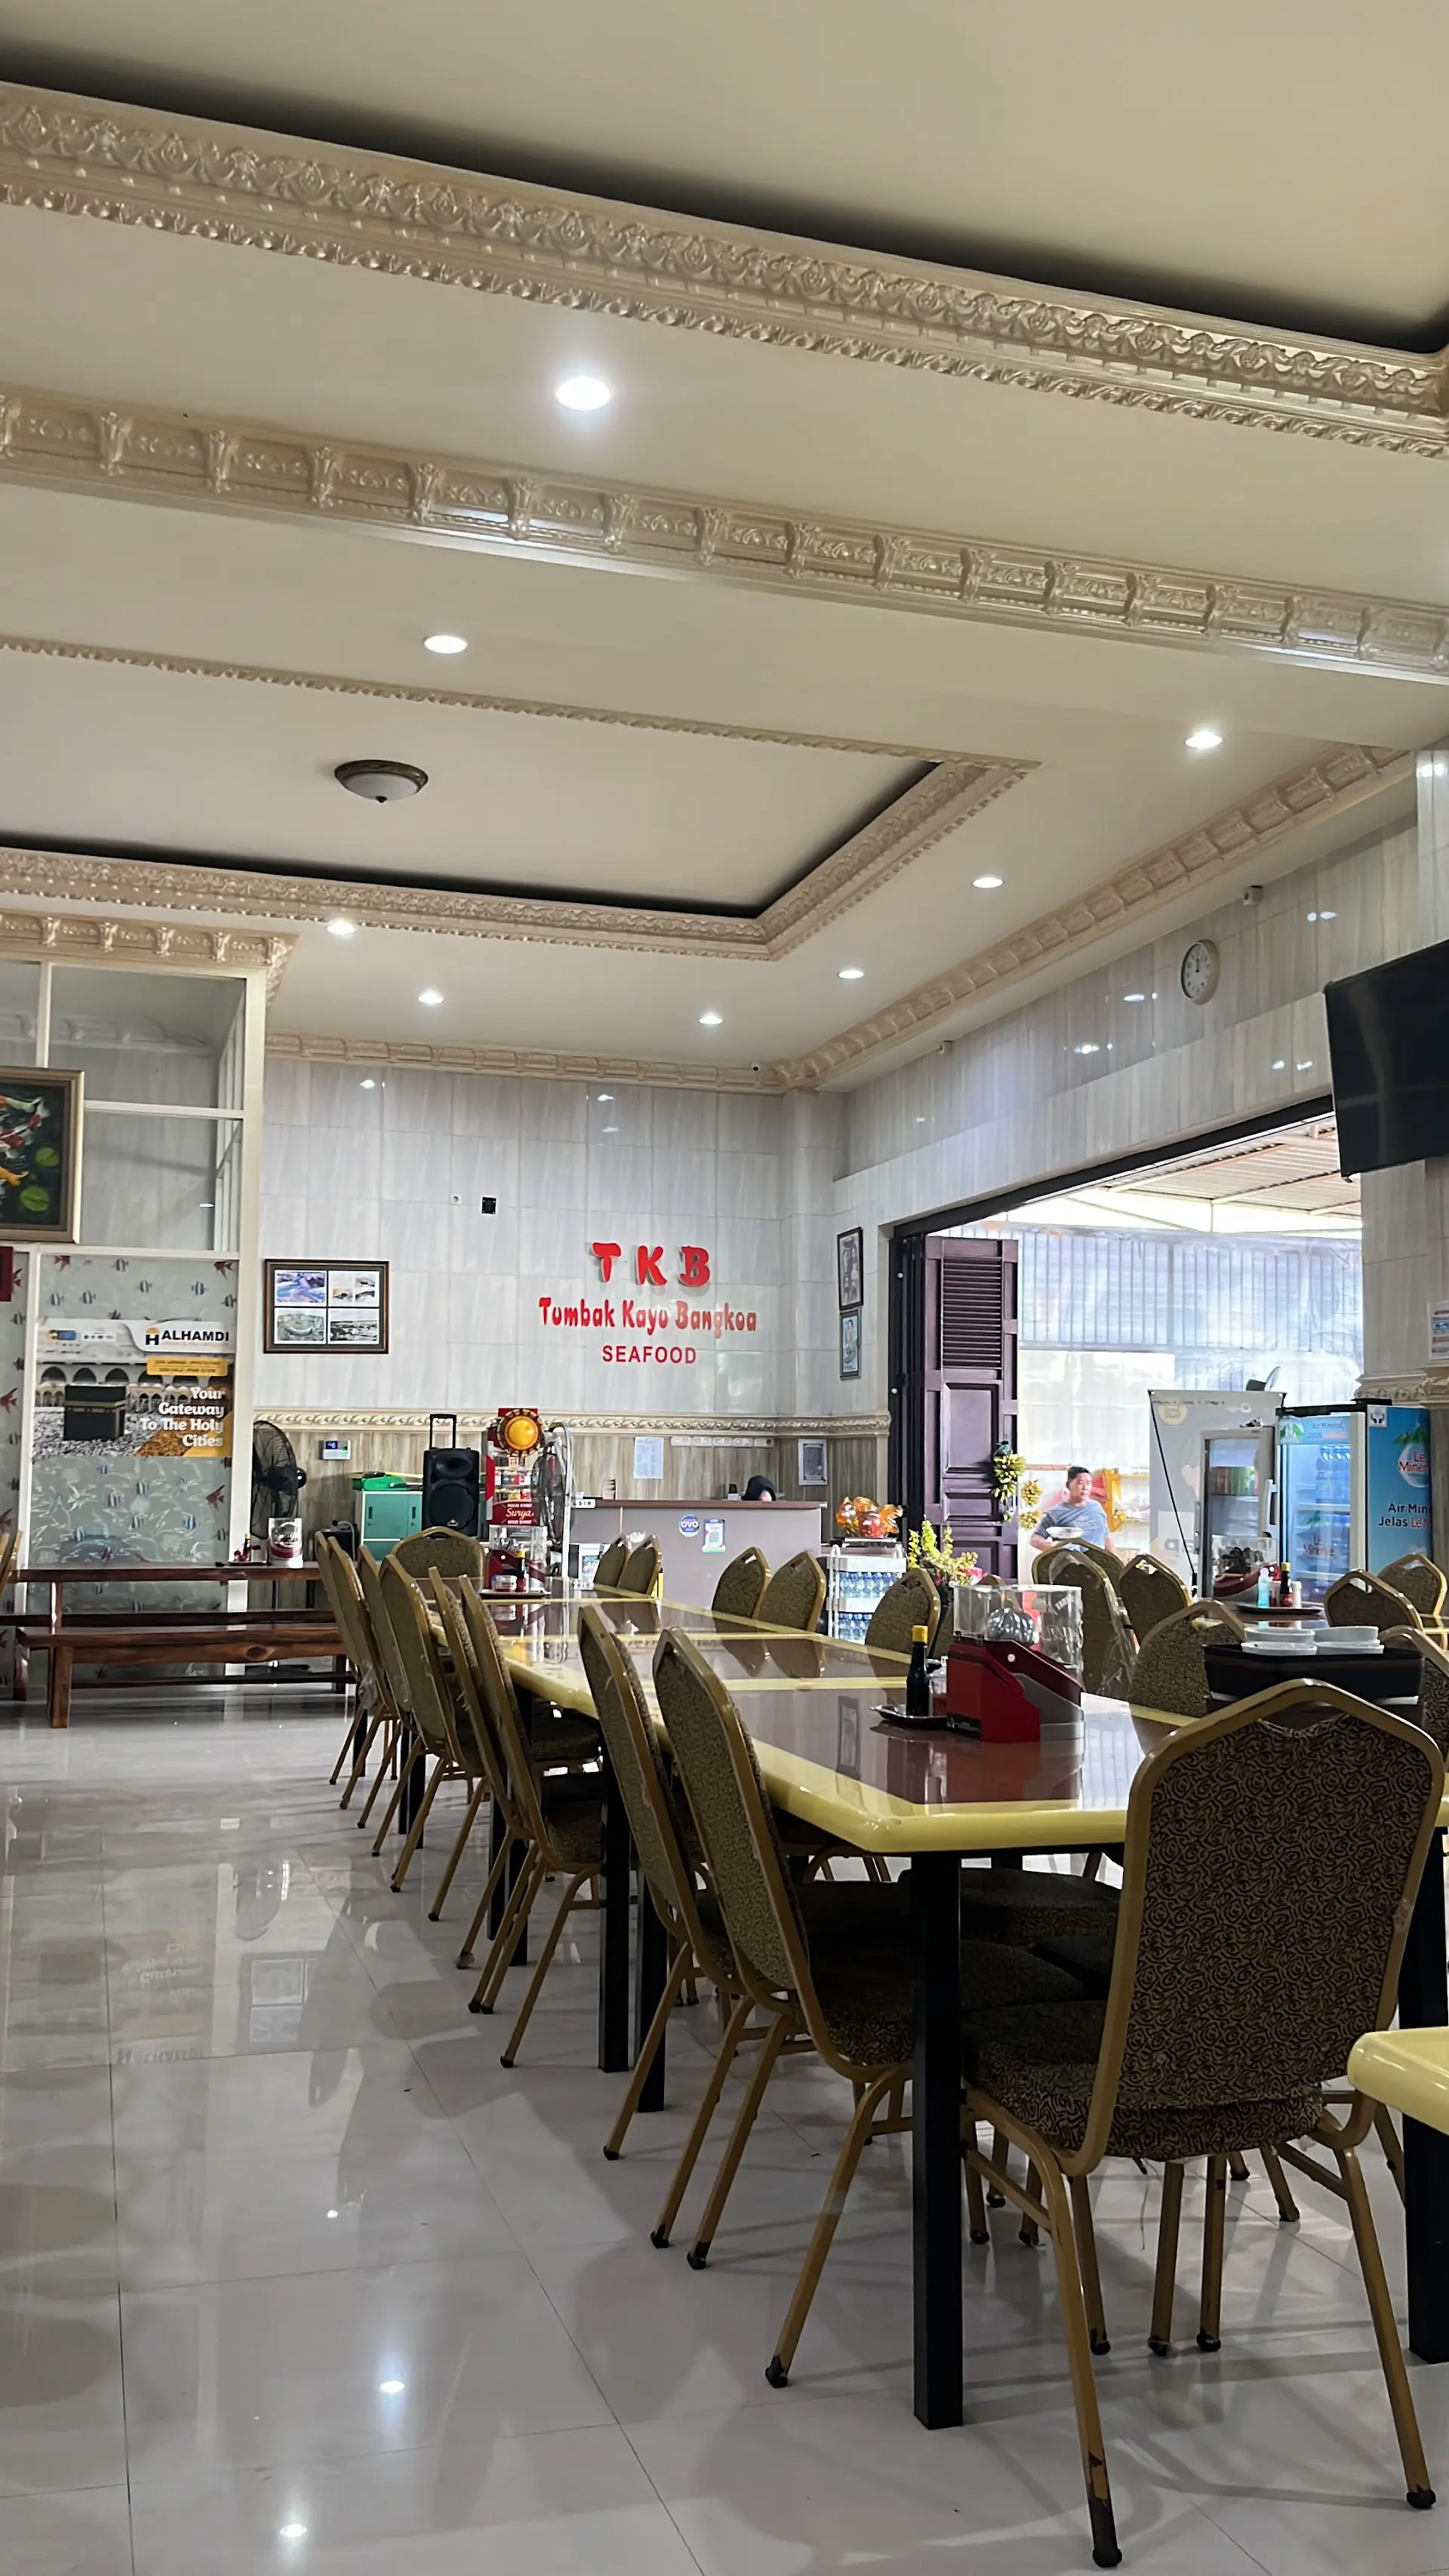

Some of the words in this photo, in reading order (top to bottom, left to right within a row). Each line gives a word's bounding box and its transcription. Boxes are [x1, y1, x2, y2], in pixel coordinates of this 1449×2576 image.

[538, 1297, 616, 1328] Tumbak
[622, 1299, 669, 1337] Kayu
[675, 1300, 758, 1339] Bangkoa
[162, 1330, 229, 1341] ALHAMDI
[601, 1345, 697, 1365] SEAFOOD
[190, 1386, 226, 1400] Your
[158, 1402, 225, 1418] Gateway
[141, 1417, 158, 1430] To
[161, 1417, 188, 1431] The
[190, 1418, 224, 1434] Holy
[182, 1433, 224, 1447] Cities
[1413, 1451, 1426, 1462] Le
[506, 1507, 531, 1520] Surya
[1388, 1502, 1404, 1513] Air
[681, 1520, 699, 1528] OVO
[1378, 1516, 1407, 1527] Jelas
